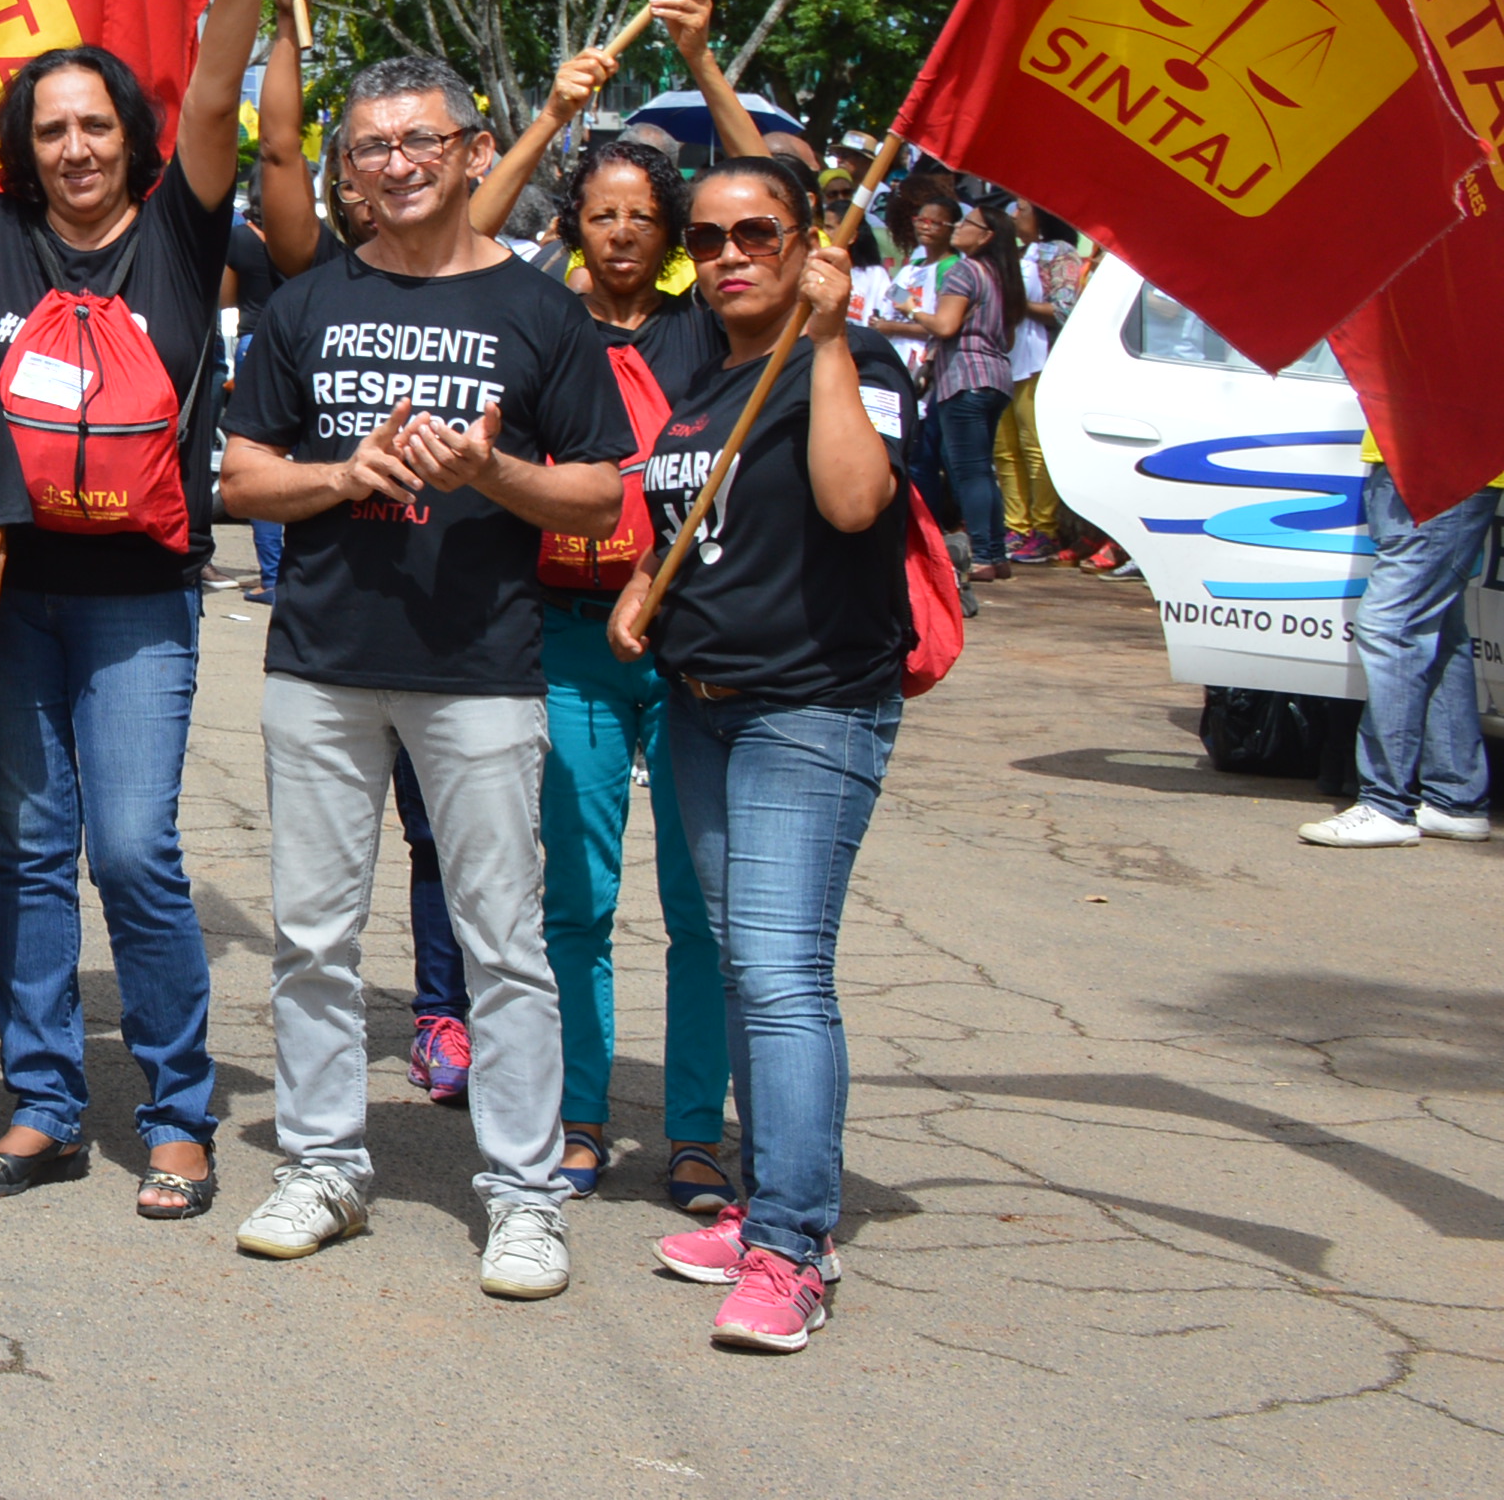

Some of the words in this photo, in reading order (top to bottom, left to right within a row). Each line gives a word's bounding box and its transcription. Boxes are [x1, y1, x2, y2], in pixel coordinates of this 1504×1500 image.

[1028, 26, 1273, 201] SINTAJ
[320, 322, 500, 369] PRESIDENTE
[312, 369, 506, 414] RESPEITE
[643, 450, 711, 492] INEAR
[350, 500, 431, 525] SINTAJ
[1281, 614, 1334, 640] DOS
